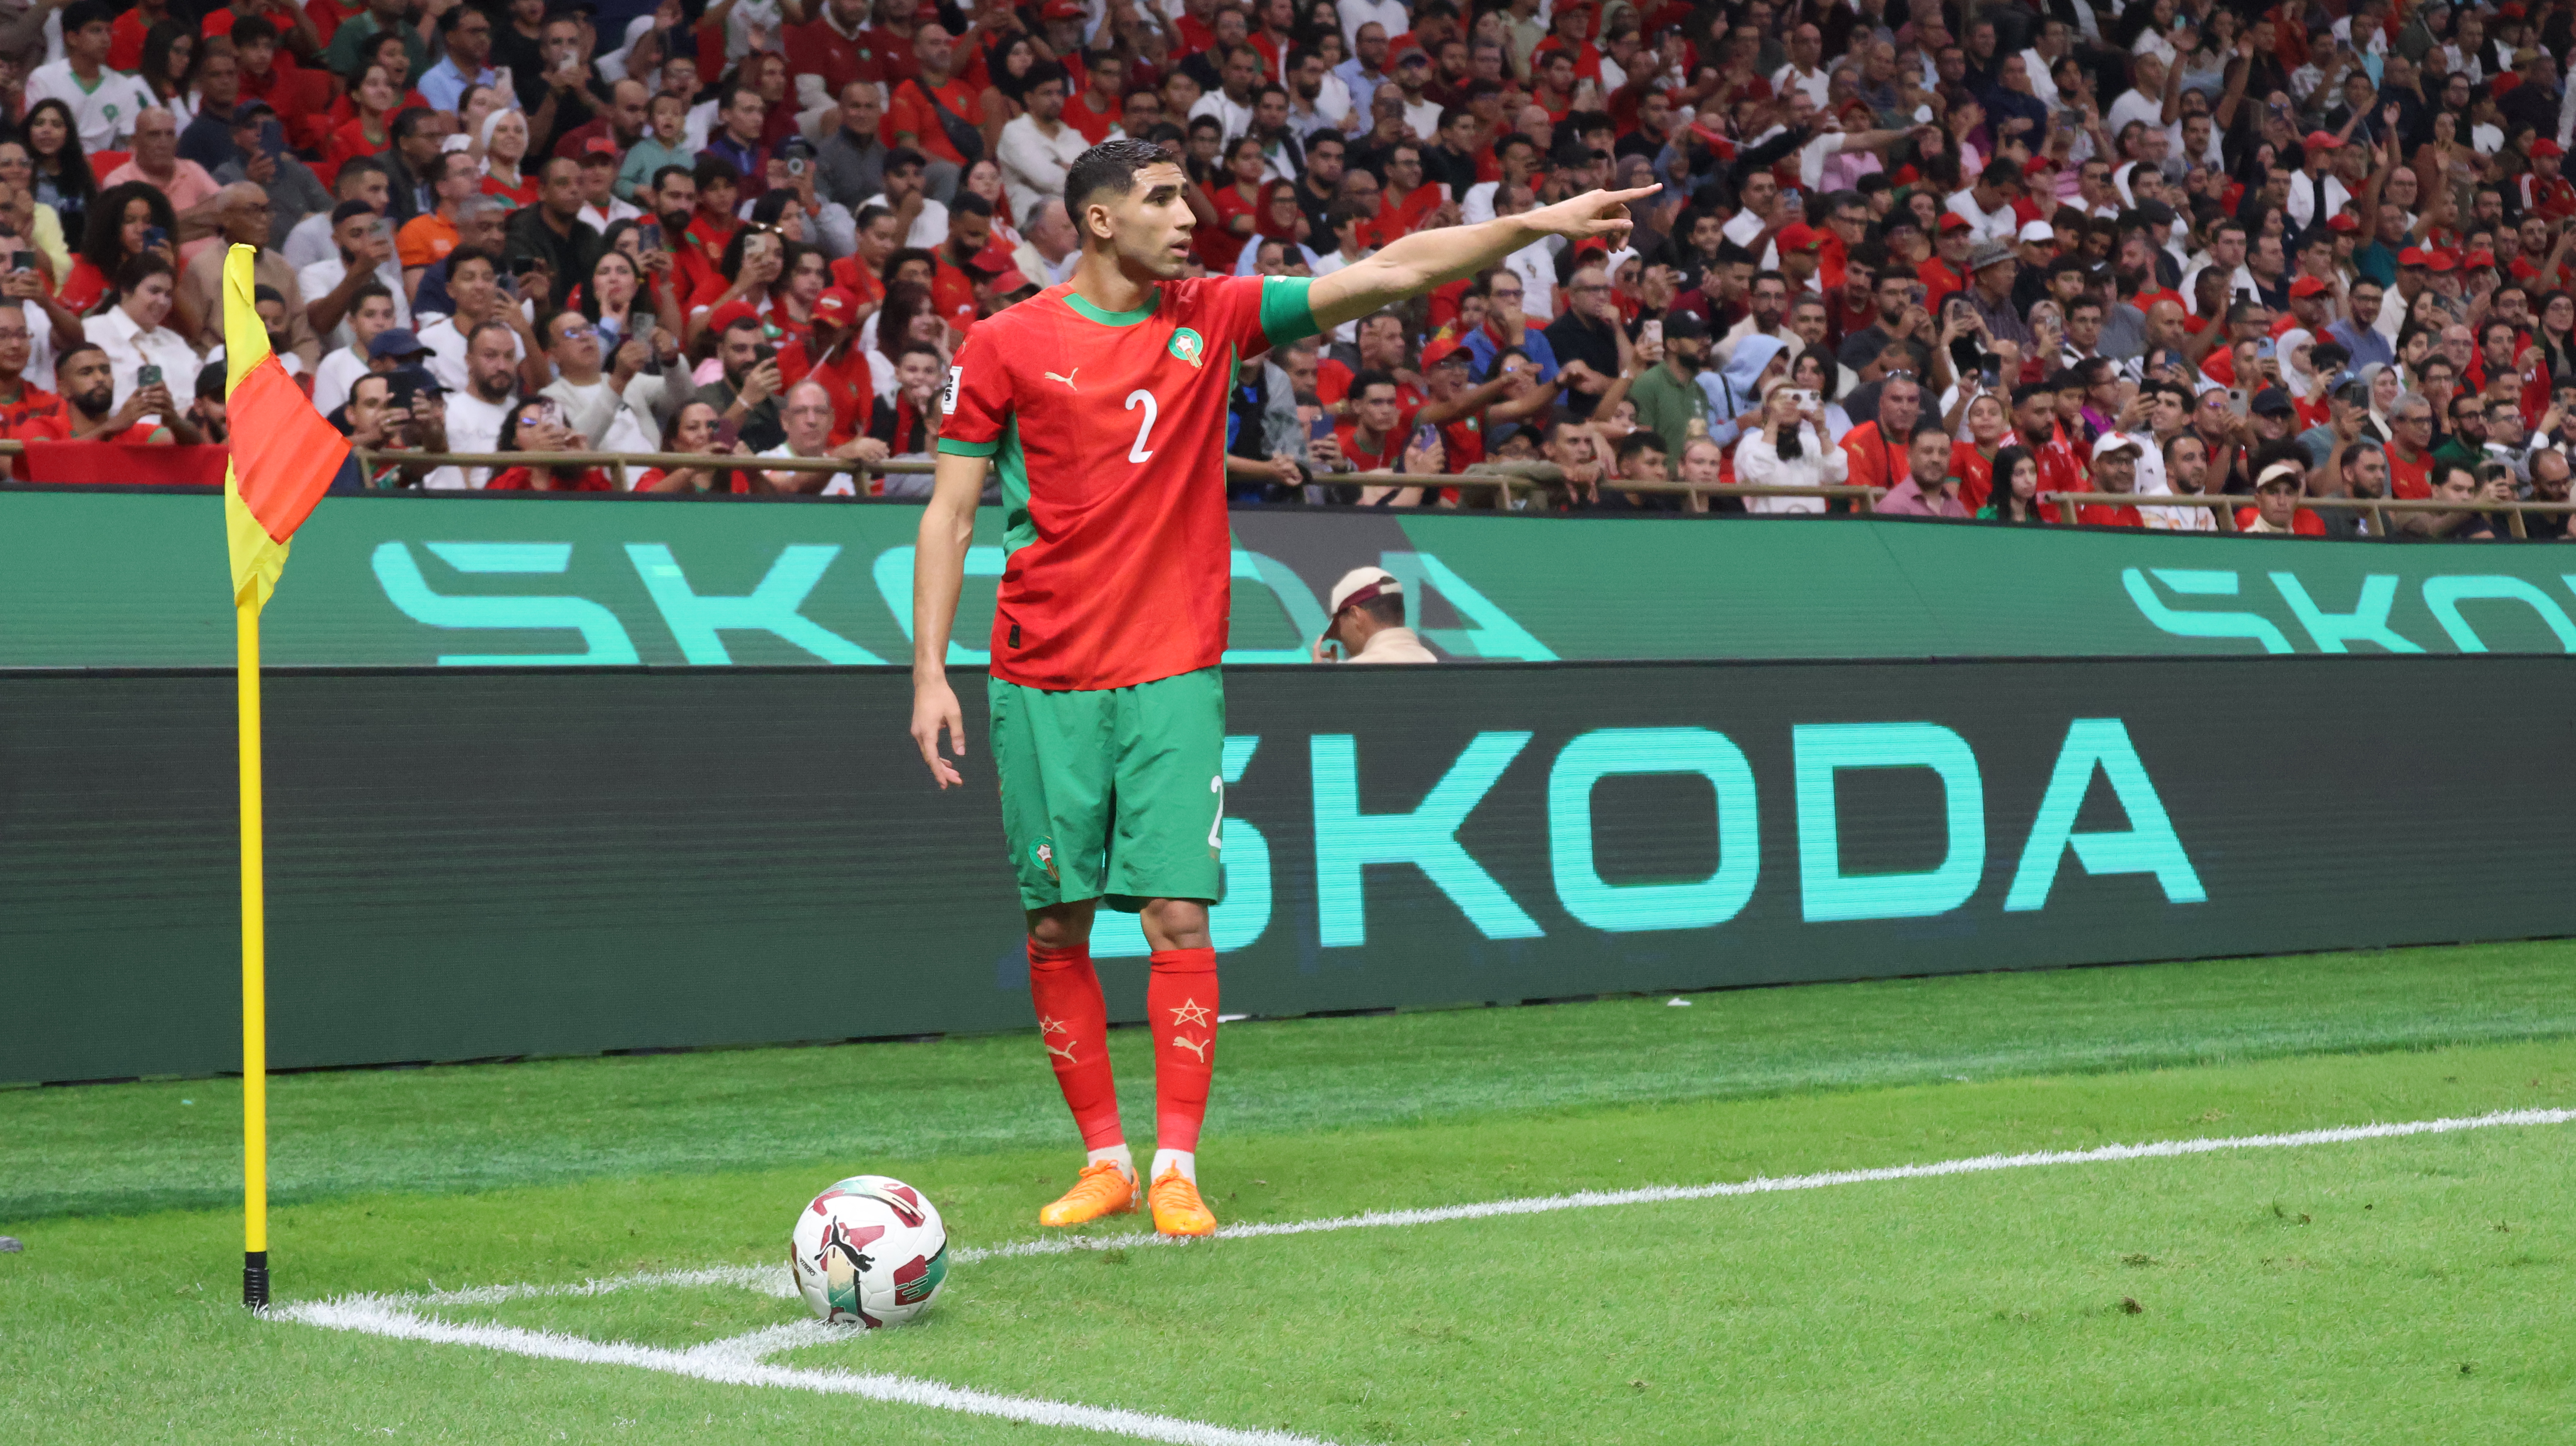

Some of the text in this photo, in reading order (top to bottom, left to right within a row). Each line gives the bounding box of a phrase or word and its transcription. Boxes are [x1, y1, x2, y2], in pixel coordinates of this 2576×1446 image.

[1125, 389, 1158, 463] 2
[371, 541, 1559, 665] SKA
[2122, 568, 2576, 653] SKO
[1208, 775, 1223, 849] 2
